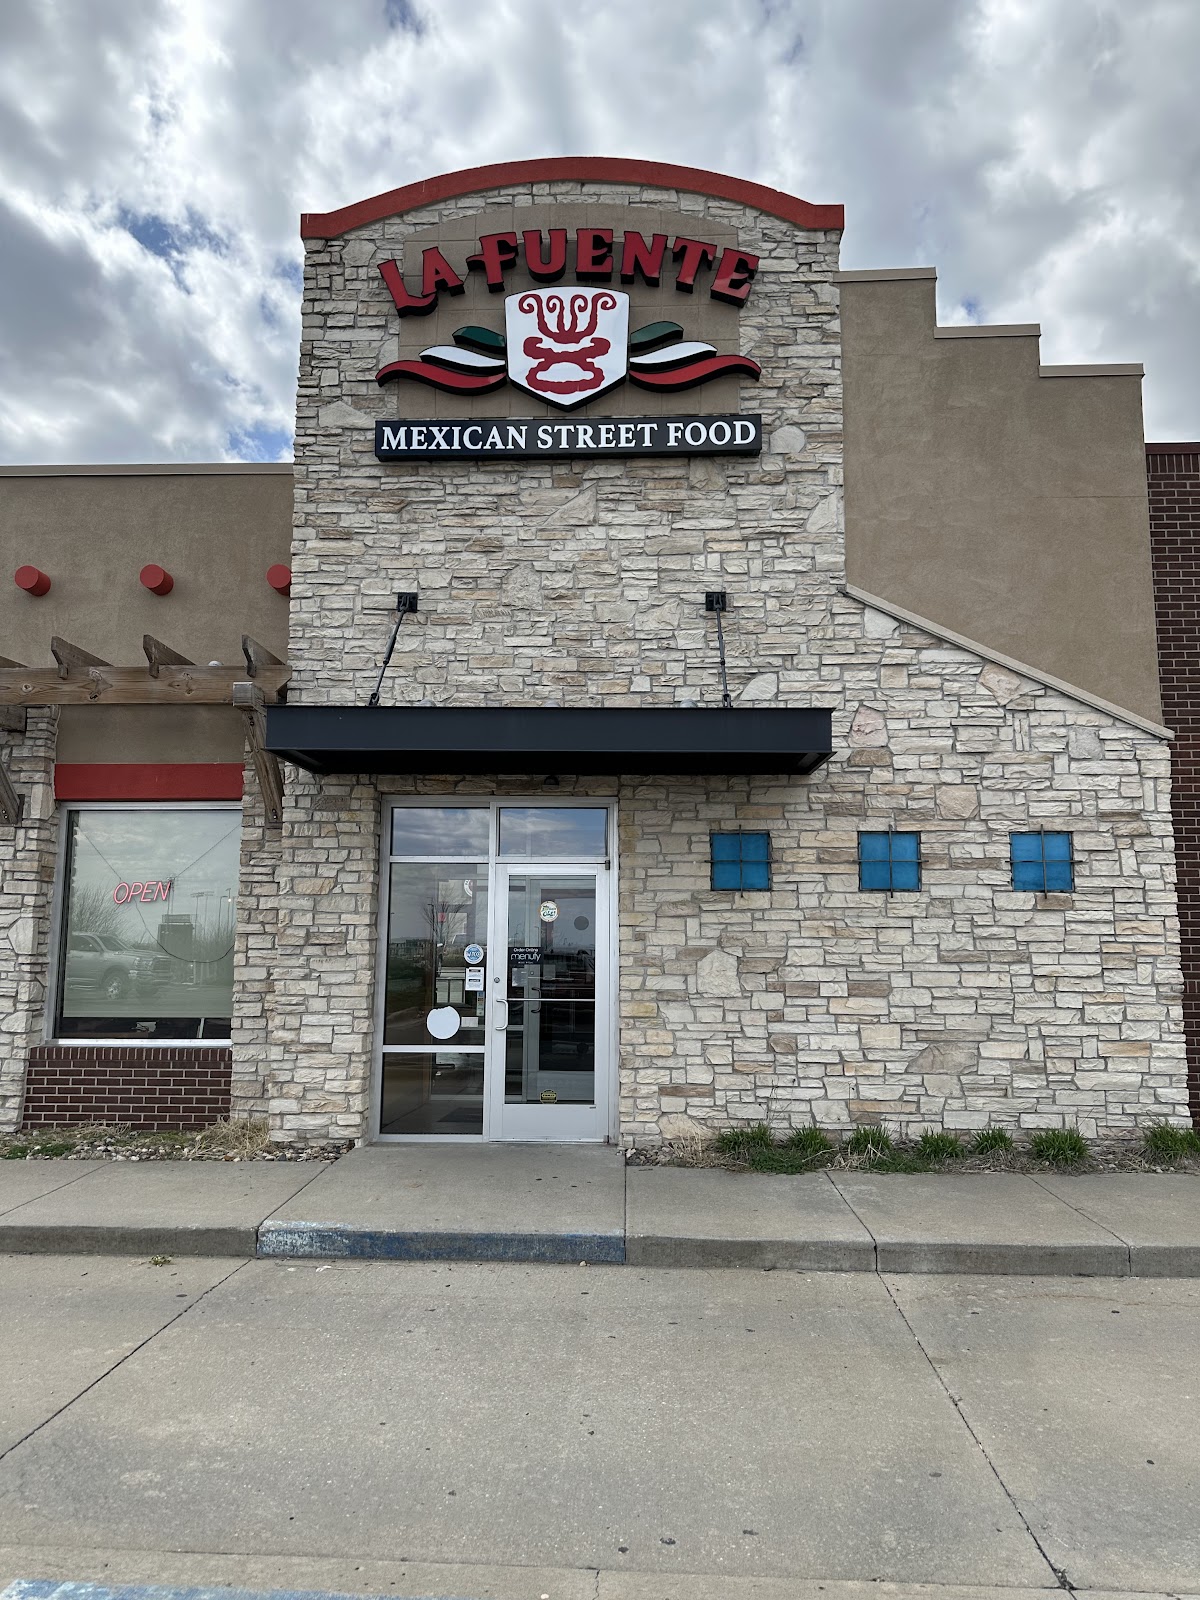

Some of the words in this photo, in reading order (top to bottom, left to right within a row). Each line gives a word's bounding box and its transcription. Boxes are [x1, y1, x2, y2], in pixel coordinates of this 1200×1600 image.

[378, 246, 465, 316] LA
[466, 228, 760, 307] FUENTE
[380, 425, 528, 450] MEXICAN
[537, 422, 658, 449] STREET
[667, 420, 757, 446] FOOD
[113, 880, 172, 904] OPEN
[510, 952, 541, 962] menufy
